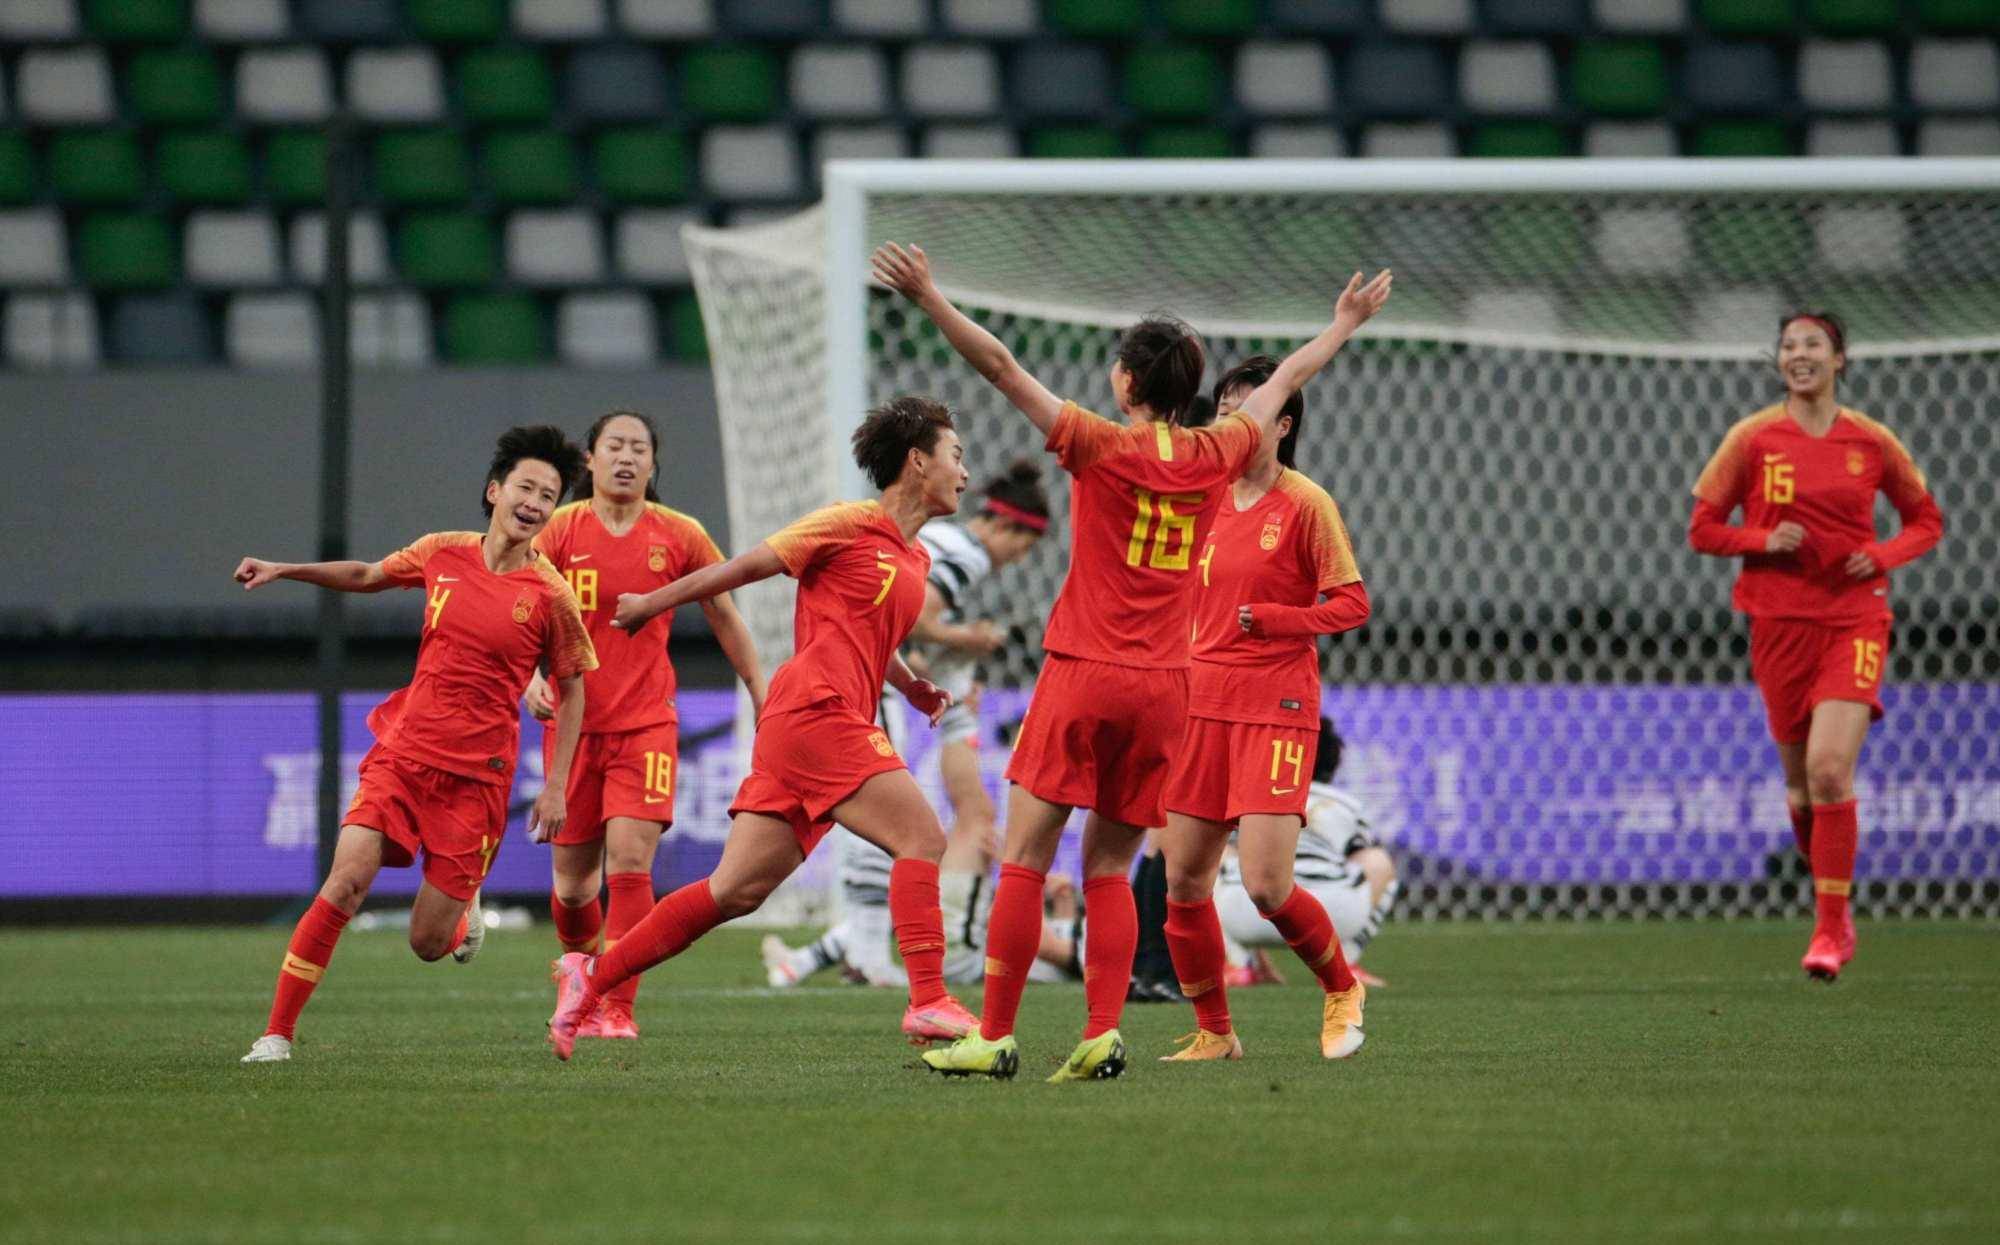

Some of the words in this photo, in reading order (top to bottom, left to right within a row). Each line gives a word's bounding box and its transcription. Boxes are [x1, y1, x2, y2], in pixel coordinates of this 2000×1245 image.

[1764, 464, 1794, 504] 15
[1126, 488, 1205, 570] 16
[873, 561, 897, 606] 7
[429, 586, 451, 629] 4
[1853, 639, 1881, 682] 15
[644, 751, 672, 797] 18
[1270, 739, 1304, 786] 14
[480, 835, 500, 877] 4
